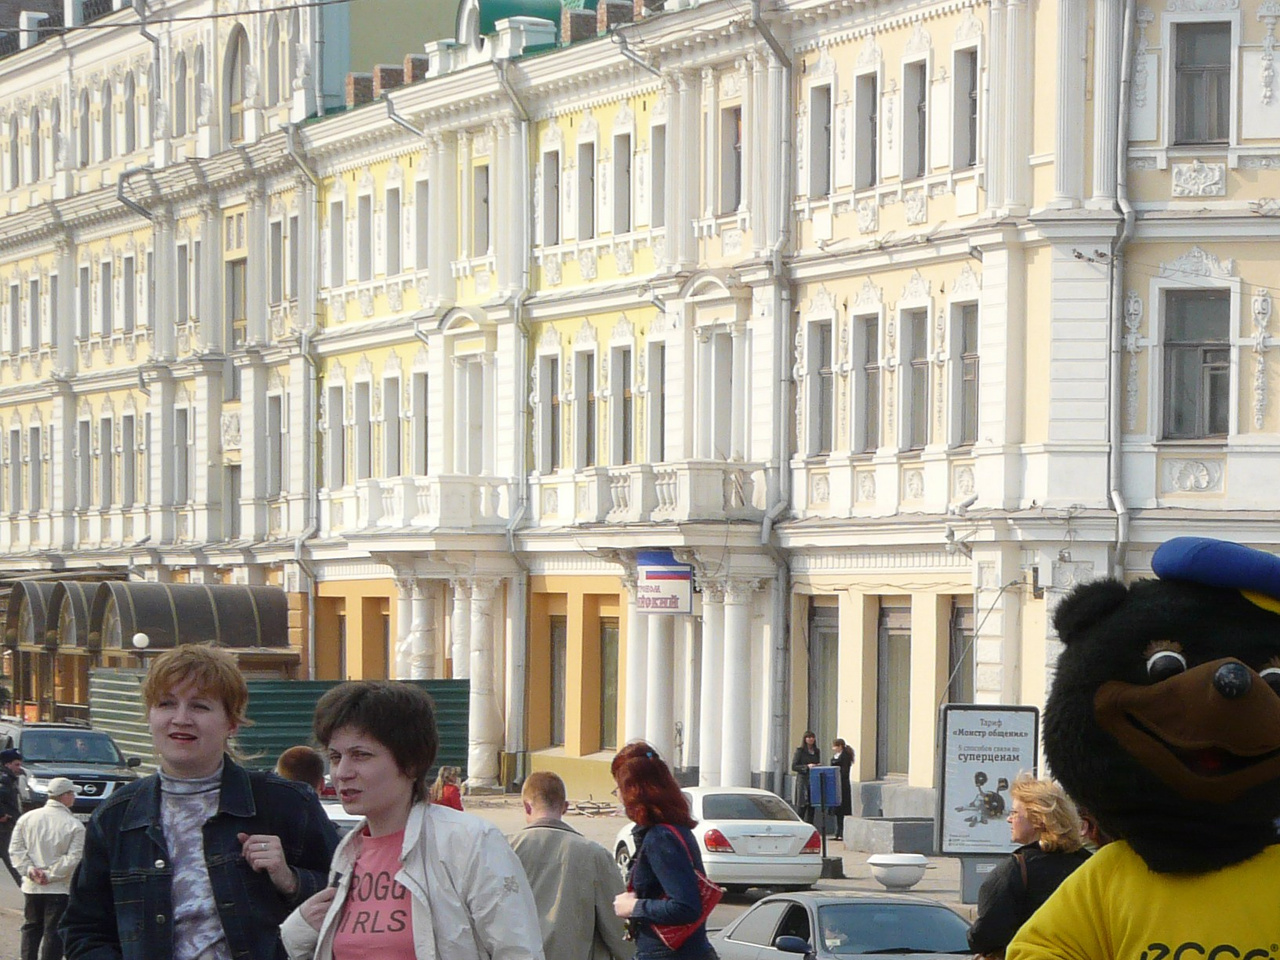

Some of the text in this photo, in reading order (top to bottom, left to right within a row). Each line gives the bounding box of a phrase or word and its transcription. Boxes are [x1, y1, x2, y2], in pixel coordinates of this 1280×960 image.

[980, 718, 1002, 728] Тариф
[958, 753, 1020, 763] суперценам
[350, 871, 407, 902] ROGG
[340, 909, 407, 934] IRLS
